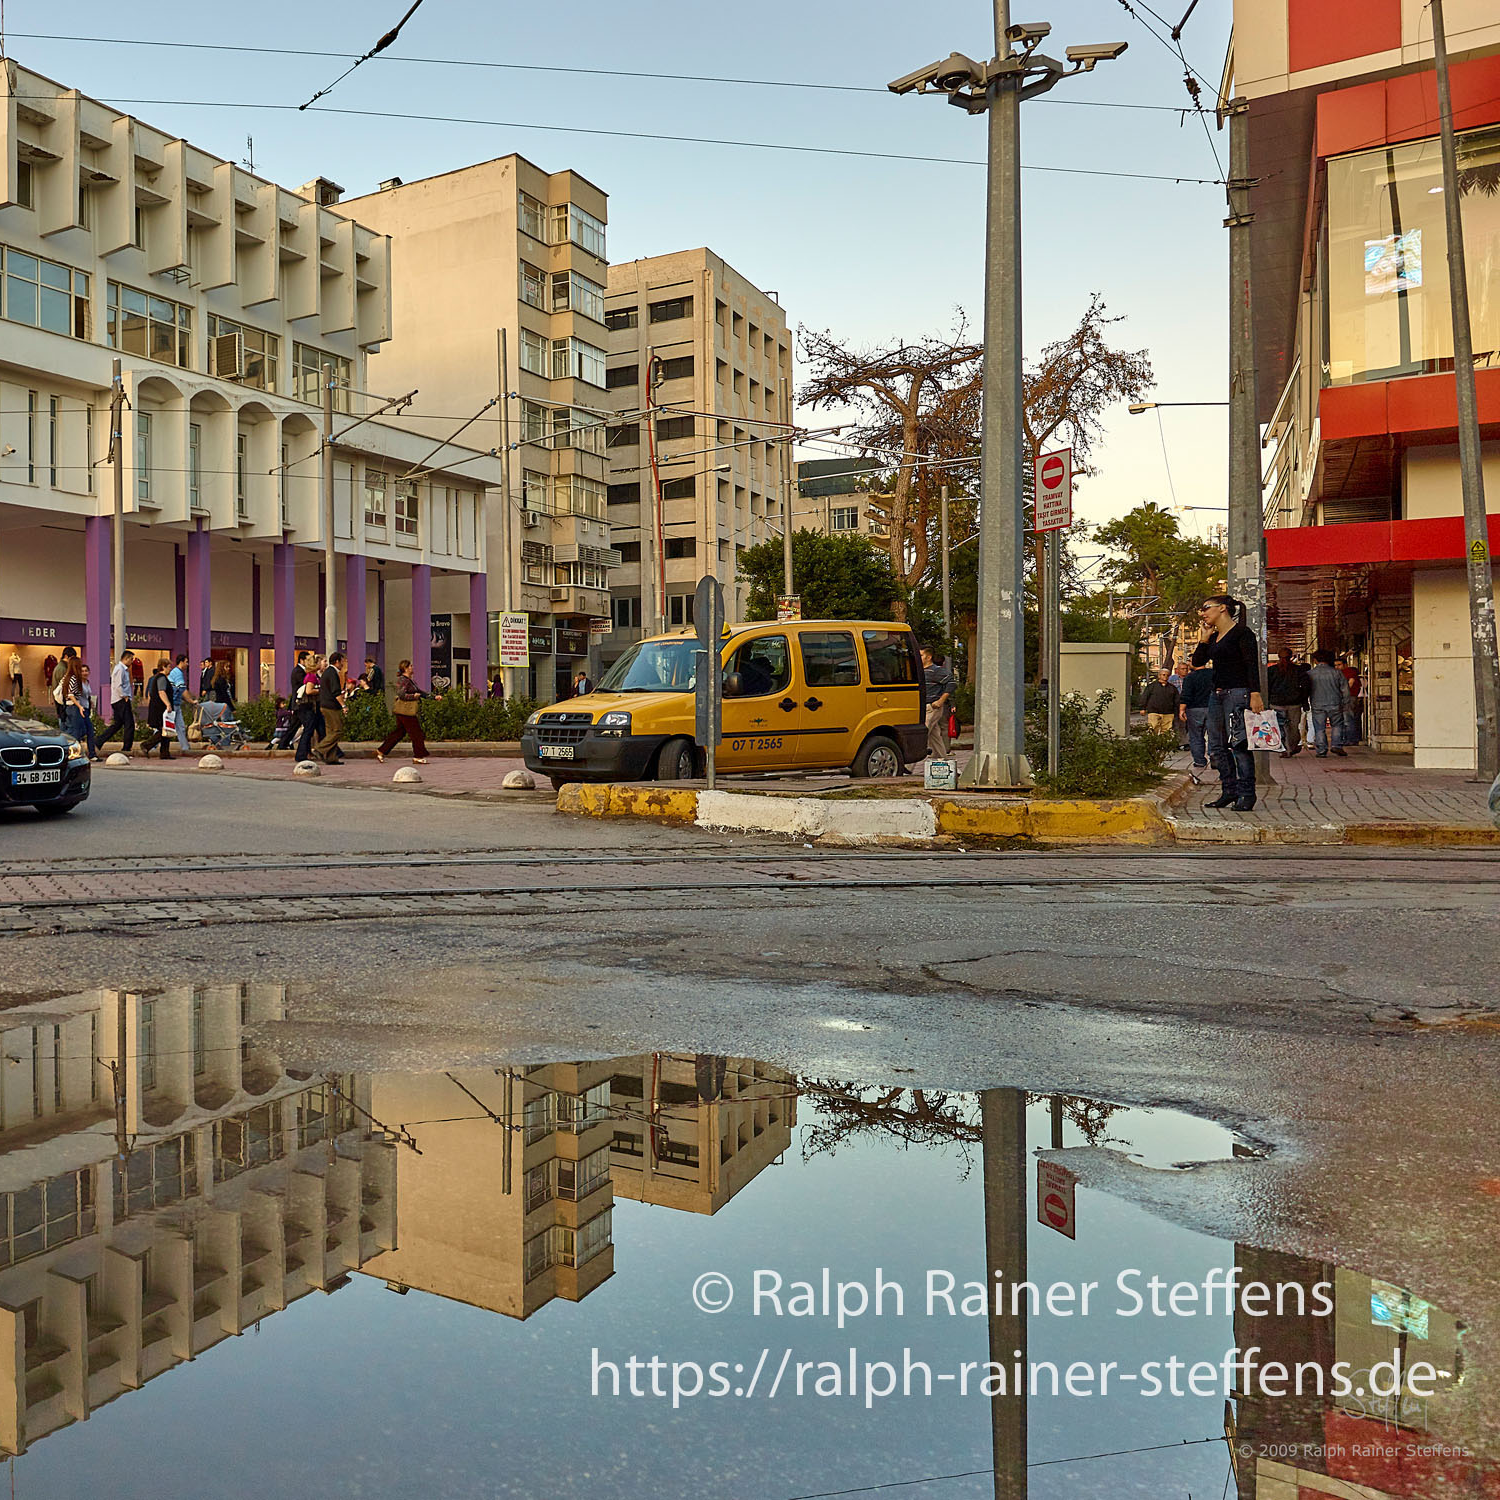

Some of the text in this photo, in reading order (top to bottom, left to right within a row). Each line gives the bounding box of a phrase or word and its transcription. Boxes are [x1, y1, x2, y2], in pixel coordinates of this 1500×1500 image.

[732, 737, 783, 751] 07 T 2565
[17, 773, 27, 783] 34
[42, 771, 59, 781] 2910
